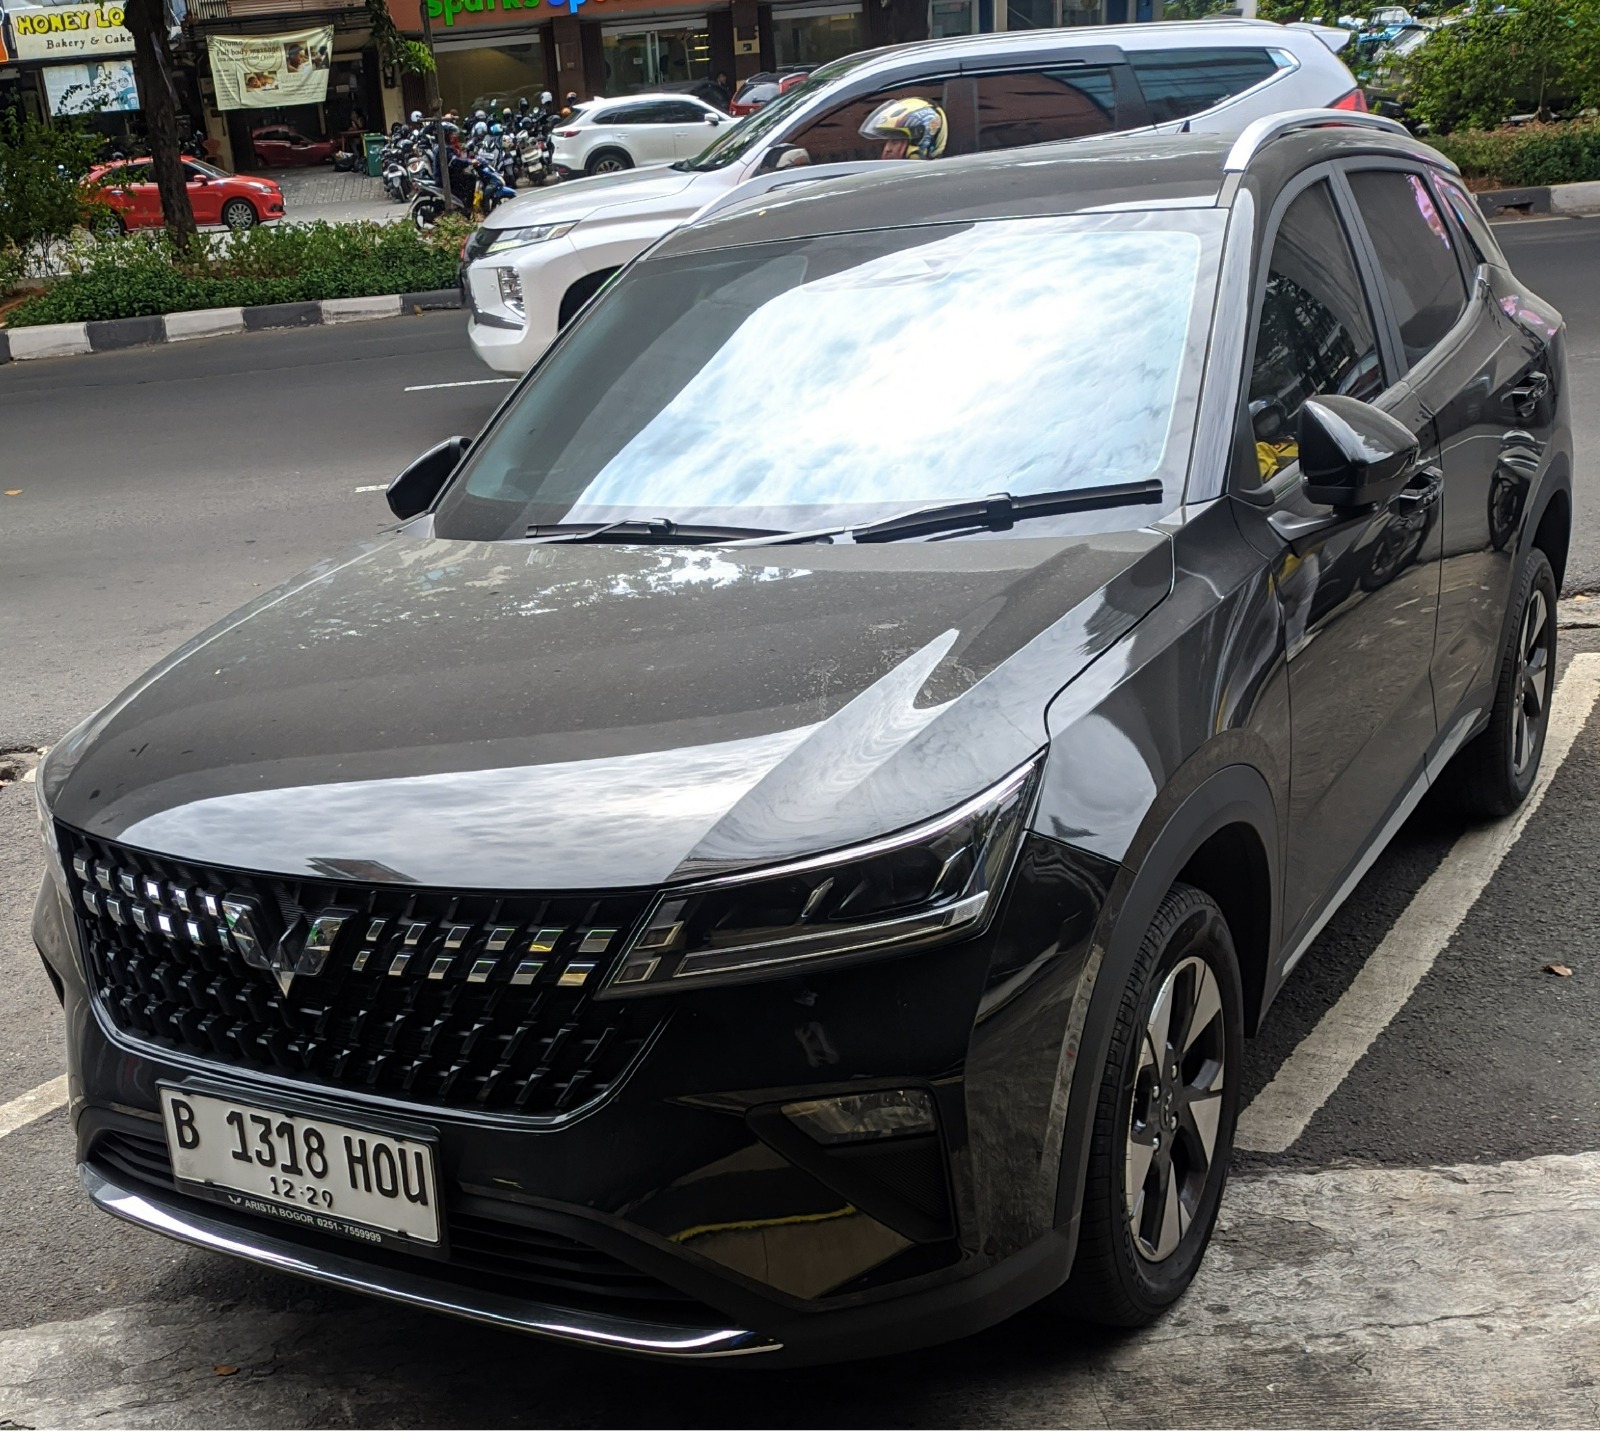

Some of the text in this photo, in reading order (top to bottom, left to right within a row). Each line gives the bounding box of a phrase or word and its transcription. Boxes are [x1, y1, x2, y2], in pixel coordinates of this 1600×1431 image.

[16, 10, 90, 35] HONEY
[46, 33, 135, 49] Bakery & Cake
[170, 1098, 428, 1206] B 1318 HOU
[245, 1200, 278, 1216] ARISTA
[279, 1208, 315, 1225] BOGOR
